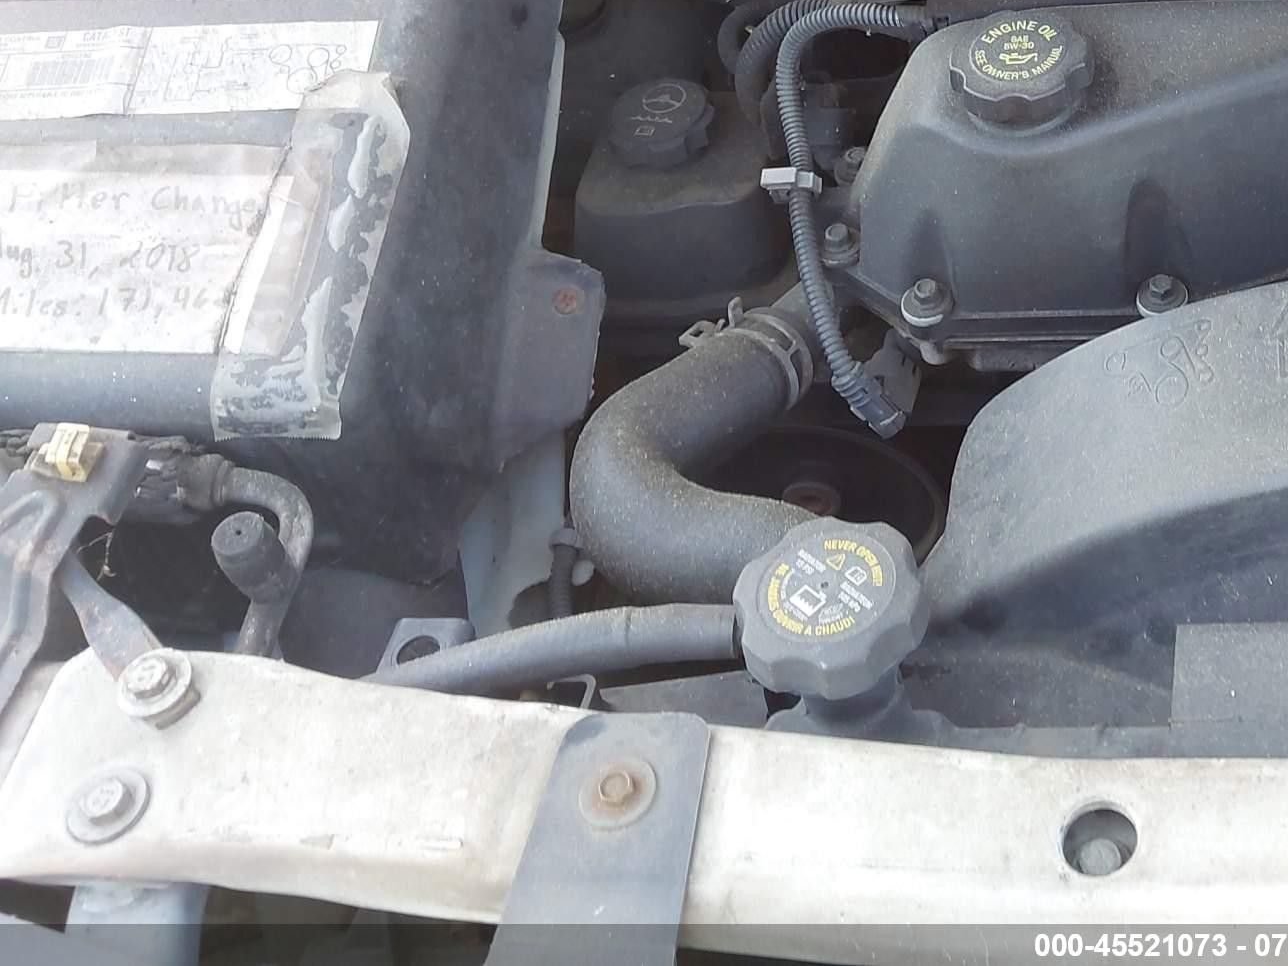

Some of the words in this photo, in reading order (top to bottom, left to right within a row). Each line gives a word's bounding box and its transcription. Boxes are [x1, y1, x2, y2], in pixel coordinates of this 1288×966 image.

[82, 27, 131, 43] CATAST
[981, 20, 1038, 44] ENGINE
[1037, 25, 1058, 41] OIL
[975, 49, 988, 69] SEE
[983, 64, 1030, 80] OWNER'S
[1031, 45, 1063, 76] MANUAL
[0, 240, 40, 278] ug.
[55, 240, 99, 279] 31,
[119, 241, 200, 273] 2018
[824, 539, 857, 553] NEVER
[857, 546, 879, 568] OPEN
